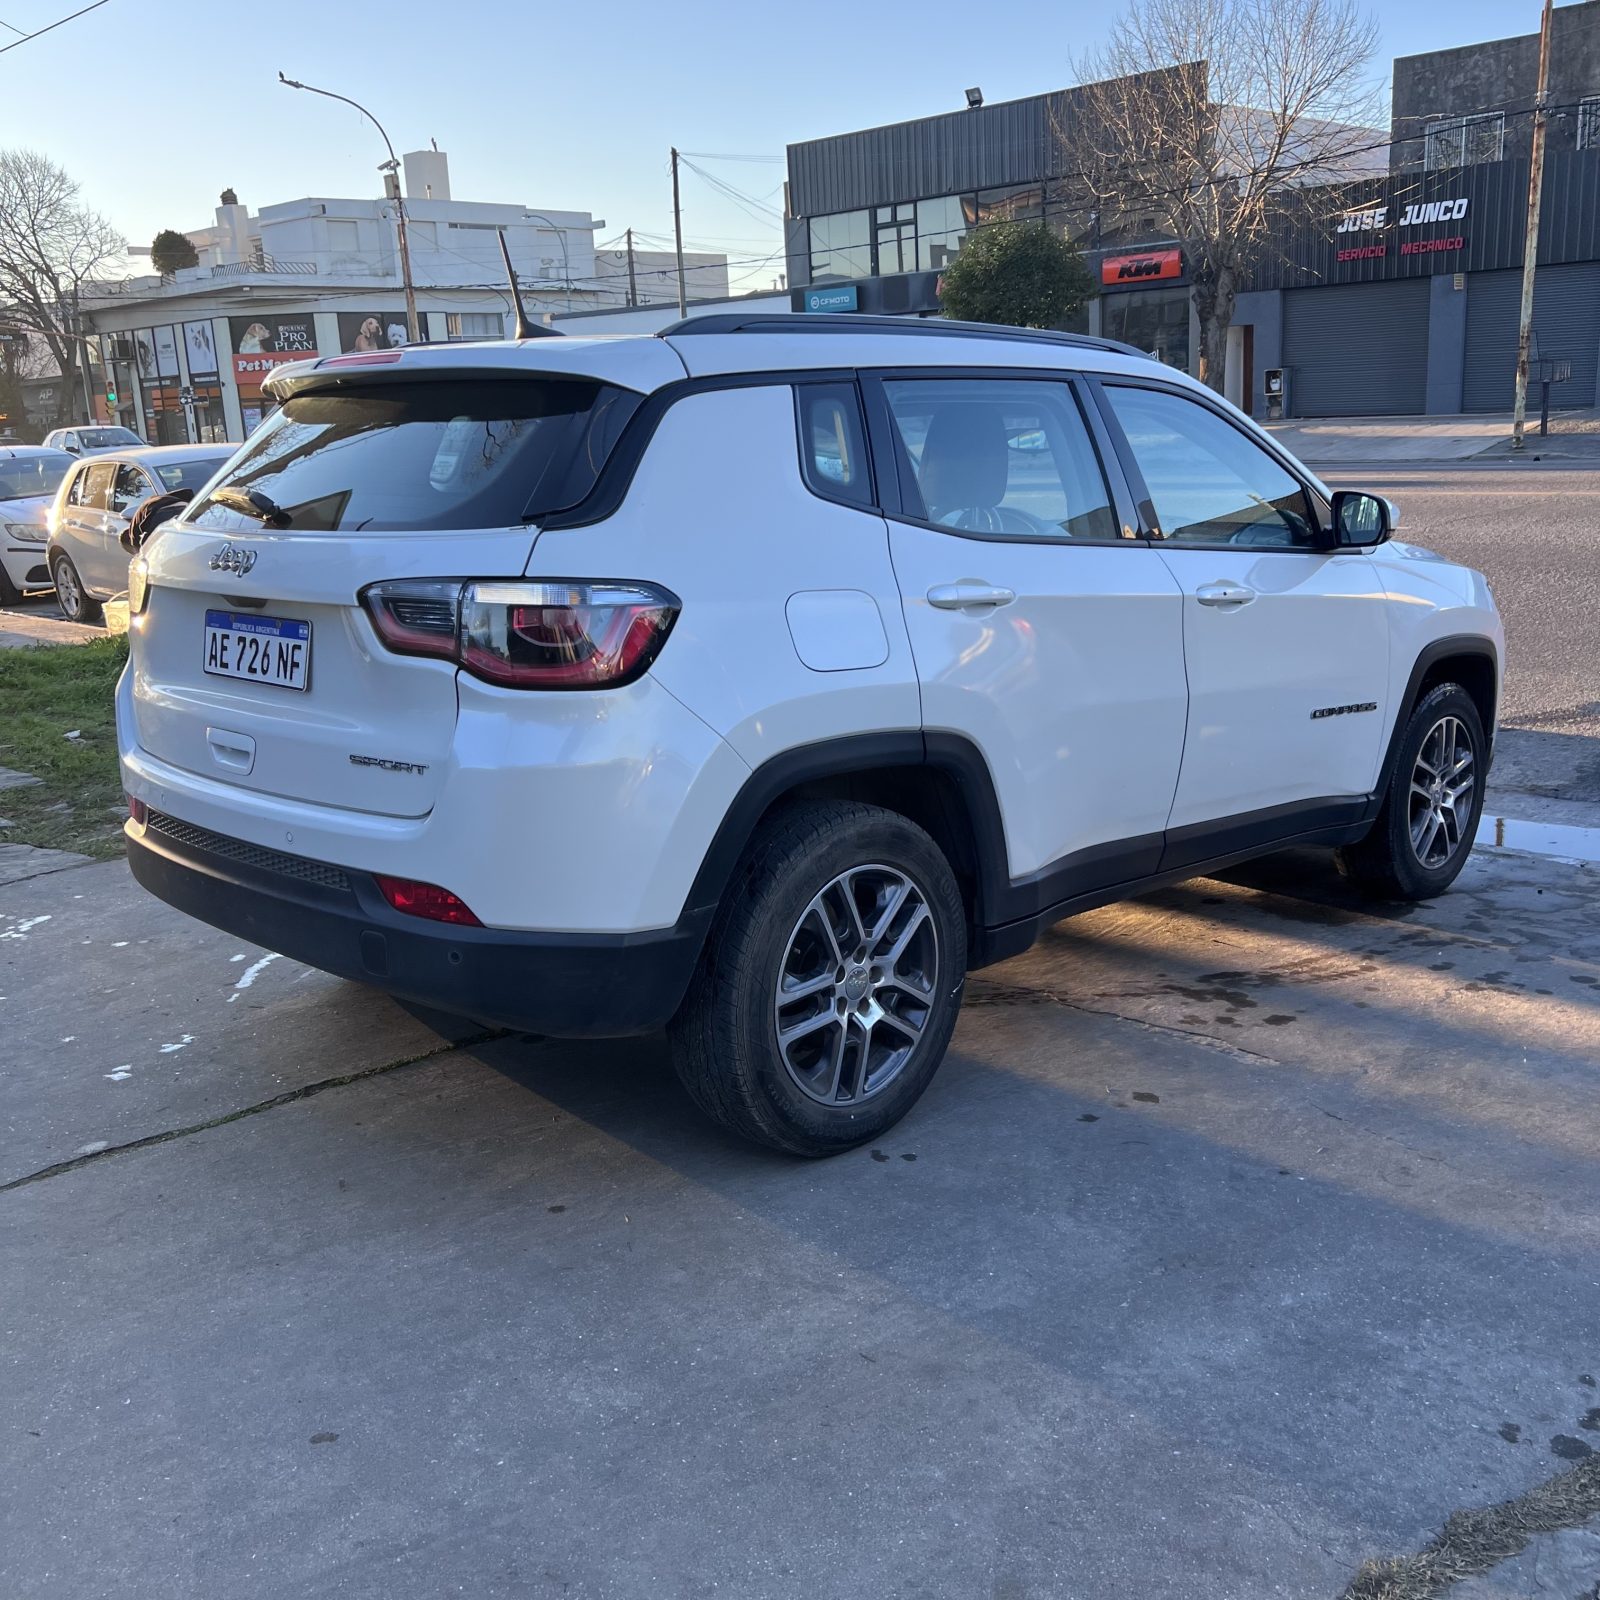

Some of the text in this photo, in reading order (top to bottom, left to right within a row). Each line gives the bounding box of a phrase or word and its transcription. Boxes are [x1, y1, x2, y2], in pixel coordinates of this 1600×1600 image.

[1337, 199, 1468, 233] JOSE JUNCO
[1337, 237, 1464, 262] SERVICIO MECANICO
[1118, 258, 1162, 279] KTM
[274, 341, 313, 351] PLAN
[280, 332, 307, 342] PRO
[208, 542, 258, 578] Jeep
[208, 632, 302, 681] AE 726 NF
[1310, 701, 1377, 720] COMPASS
[349, 754, 430, 776] SPORT
